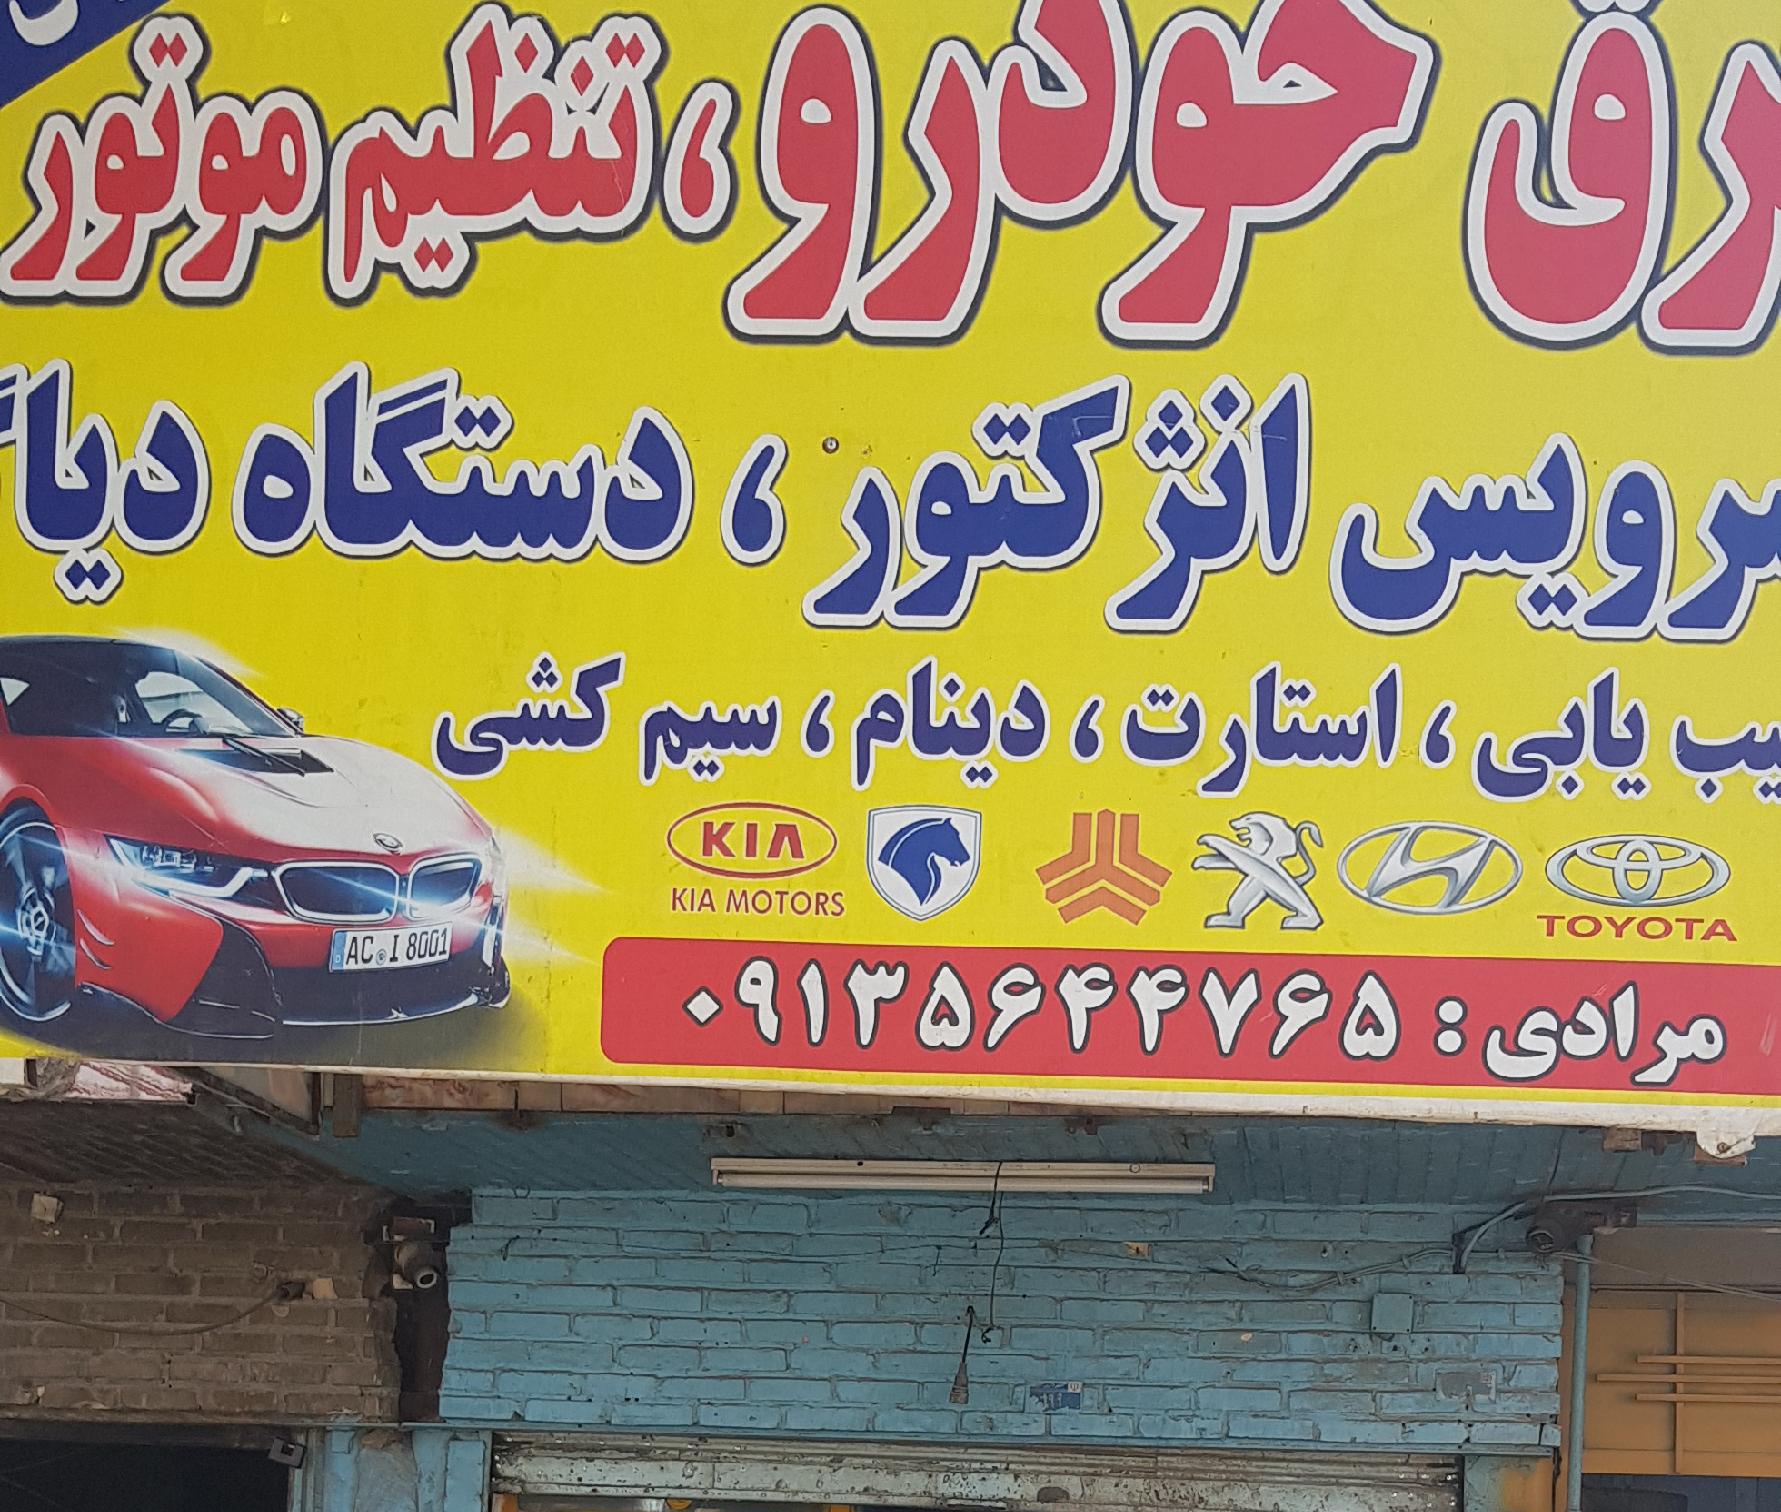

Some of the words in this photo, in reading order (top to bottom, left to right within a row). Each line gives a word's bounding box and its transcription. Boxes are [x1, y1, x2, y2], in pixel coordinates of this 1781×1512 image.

[0, 14, 325, 302] موتور
[328, 2, 668, 300] تنظیم
[720, 0, 1440, 347] خودرو
[1463, 0, 1781, 353] رق
[0, 359, 208, 604] دیا
[232, 361, 692, 562] دستگاه
[803, 374, 1308, 630] انژکتور
[1330, 433, 1781, 640] رویس
[432, 651, 626, 778] کشی
[639, 692, 783, 786] سیم
[850, 654, 1048, 791] دینام
[1120, 661, 1402, 799] استارت
[1471, 666, 1650, 803] یابی
[1670, 714, 1781, 804] یب
[670, 886, 717, 914] KIA
[726, 887, 846, 918] MOTORS
[700, 820, 805, 861] KIA
[345, 935, 374, 966] AC
[405, 927, 449, 962] 8001
[1535, 914, 1738, 943] TOYOTA
[682, 955, 1401, 1062] ۰۹۱۳۵۶۴۴۷۶۵
